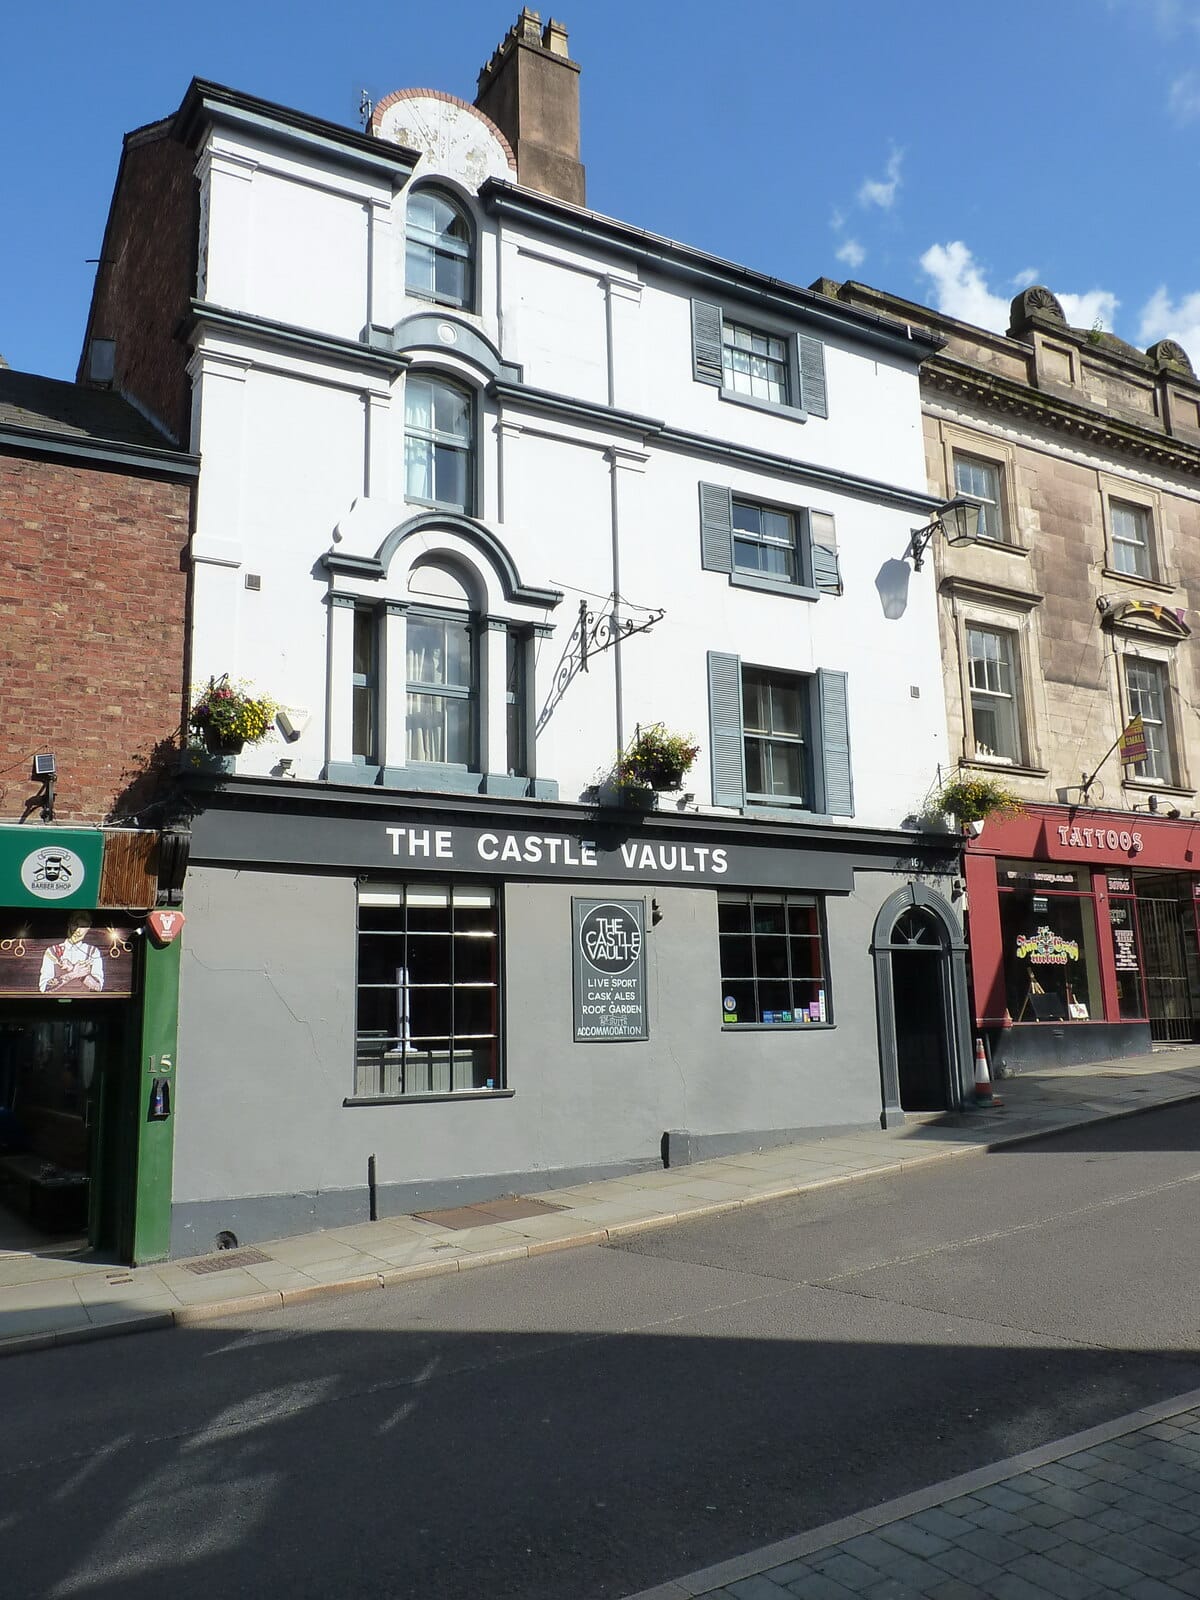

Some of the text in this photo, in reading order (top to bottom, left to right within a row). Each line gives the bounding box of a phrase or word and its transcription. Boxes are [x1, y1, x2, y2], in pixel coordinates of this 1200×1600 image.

[1058, 826, 1144, 852] TATTOOS
[386, 827, 728, 873] THE CASTLE VAULTS
[910, 857, 920, 867] 16
[596, 918, 623, 933] THE
[586, 931, 641, 947] CASTLE
[587, 944, 640, 960] VAULTS
[587, 978, 637, 988] LIVE SPORT
[587, 992, 635, 1001] CASK ALES
[582, 1004, 642, 1014] ROOF GARDEN
[577, 1026, 642, 1036] ACCOMMODATION
[147, 1054, 172, 1074] 15
